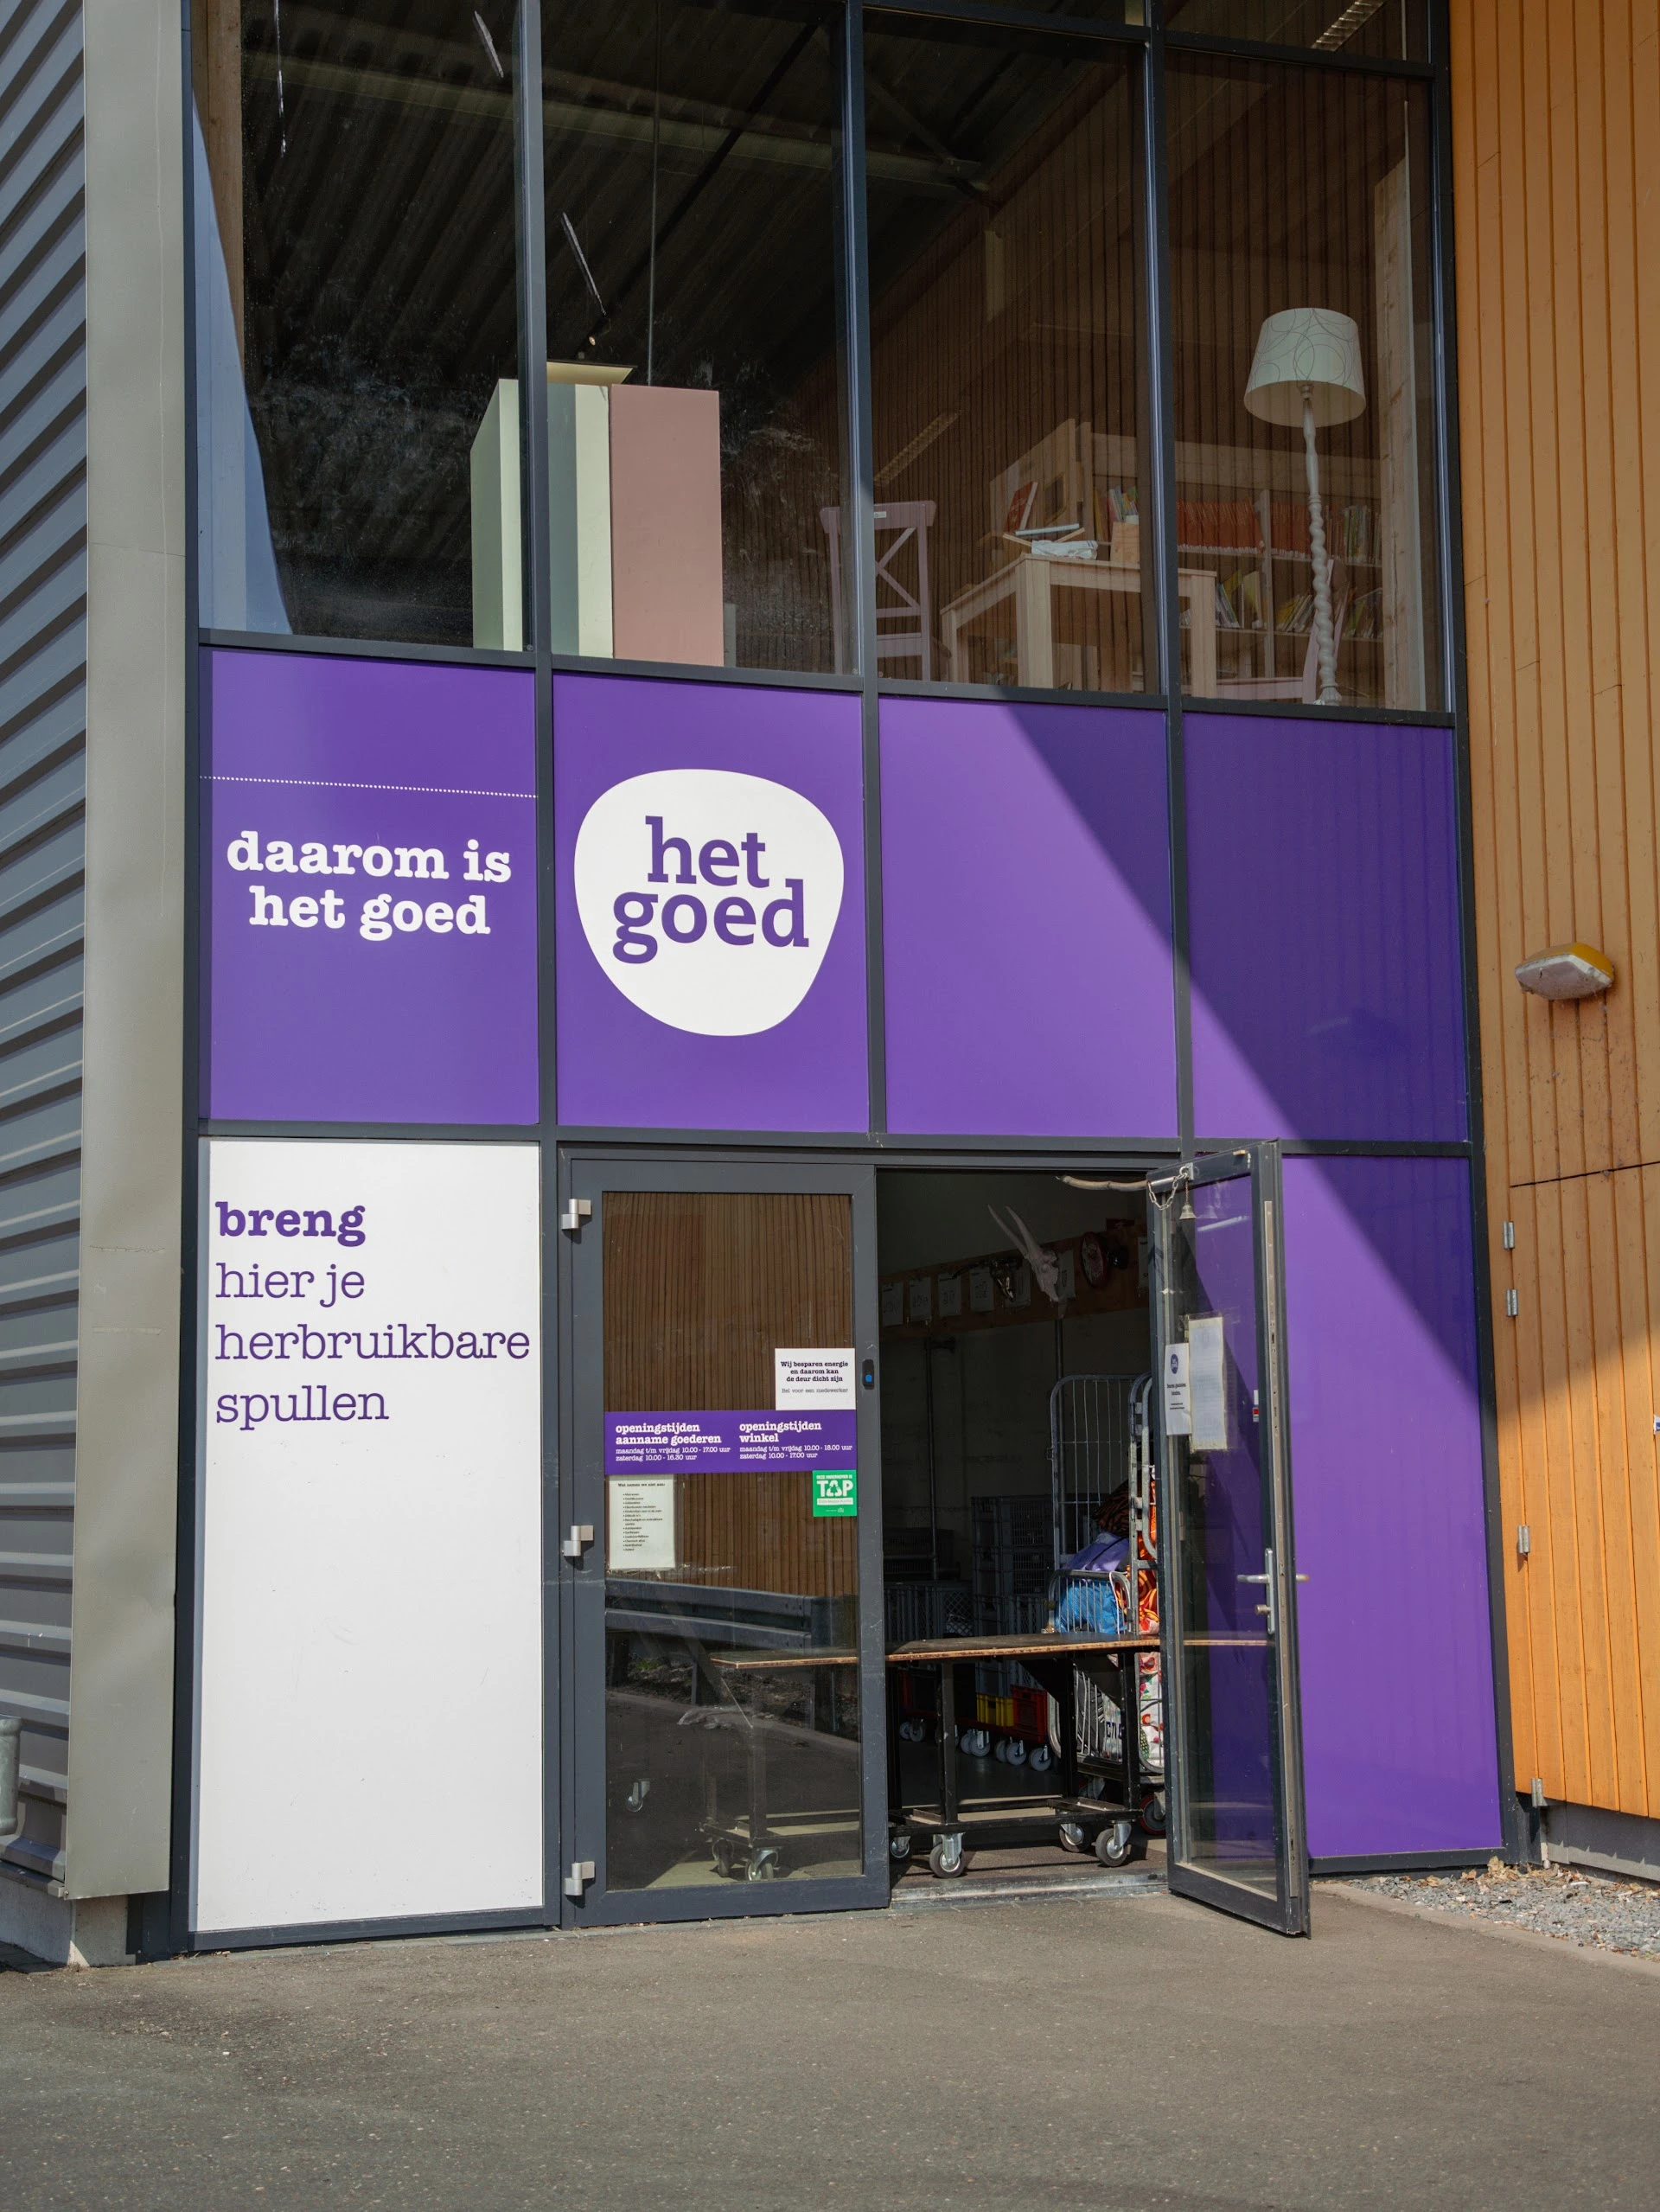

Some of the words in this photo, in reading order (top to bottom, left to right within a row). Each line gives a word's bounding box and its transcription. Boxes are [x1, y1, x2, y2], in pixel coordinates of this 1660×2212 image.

[227, 831, 449, 879] daarom
[463, 840, 511, 882] is
[646, 815, 769, 888] het
[249, 885, 345, 929] het
[360, 894, 490, 941] goed
[613, 878, 808, 963] goed
[215, 1201, 366, 1247] breng
[216, 1263, 314, 1298] hier
[320, 1264, 364, 1307] je
[215, 1324, 529, 1359] herbruikbare
[217, 1385, 389, 1430] spullen
[616, 1422, 700, 1435] openingstijden
[739, 1422, 821, 1433] openingstijden
[671, 1435, 721, 1446] goederen
[739, 1433, 779, 1442] winkel
